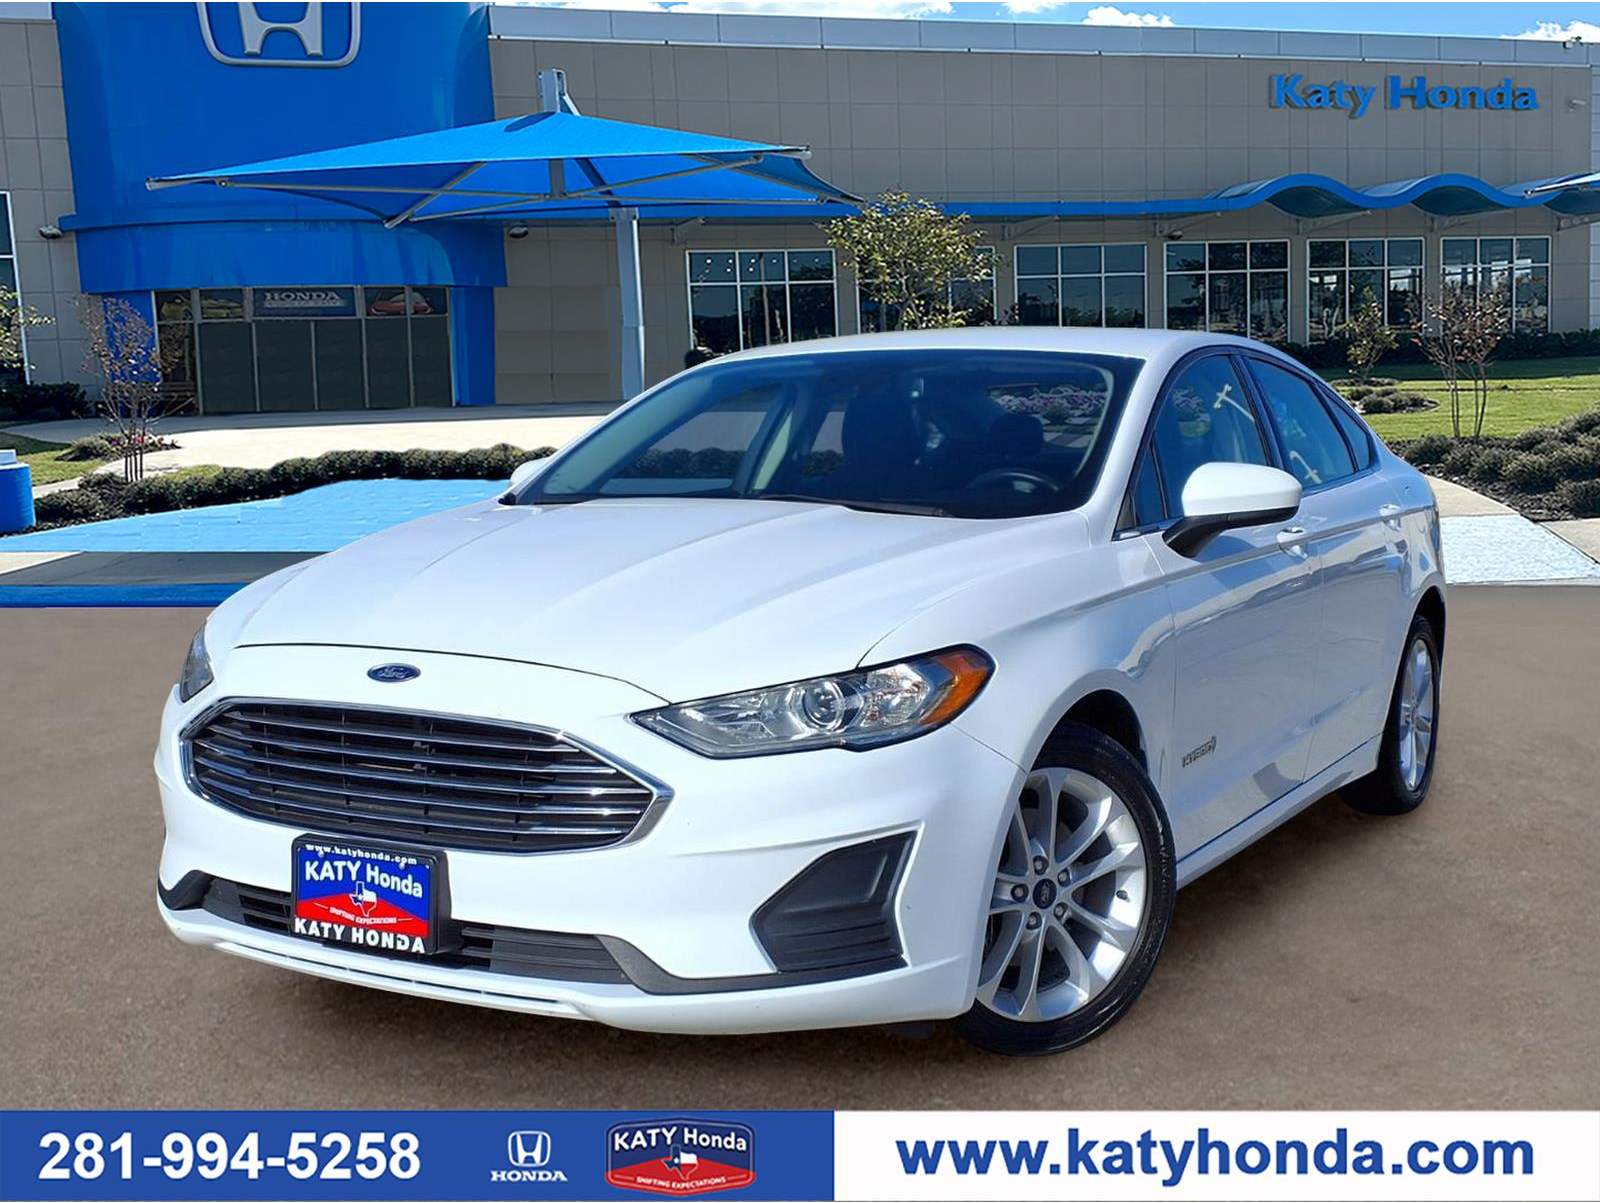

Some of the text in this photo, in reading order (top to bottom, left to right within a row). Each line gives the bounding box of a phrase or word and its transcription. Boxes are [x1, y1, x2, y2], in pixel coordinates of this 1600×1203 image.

[1270, 73, 1539, 119] Katy Honda
[265, 291, 340, 301] HONDA
[305, 844, 417, 865] www.katyhonda.com
[305, 860, 423, 898] KATY Honda
[294, 917, 426, 954] KATY HONDA
